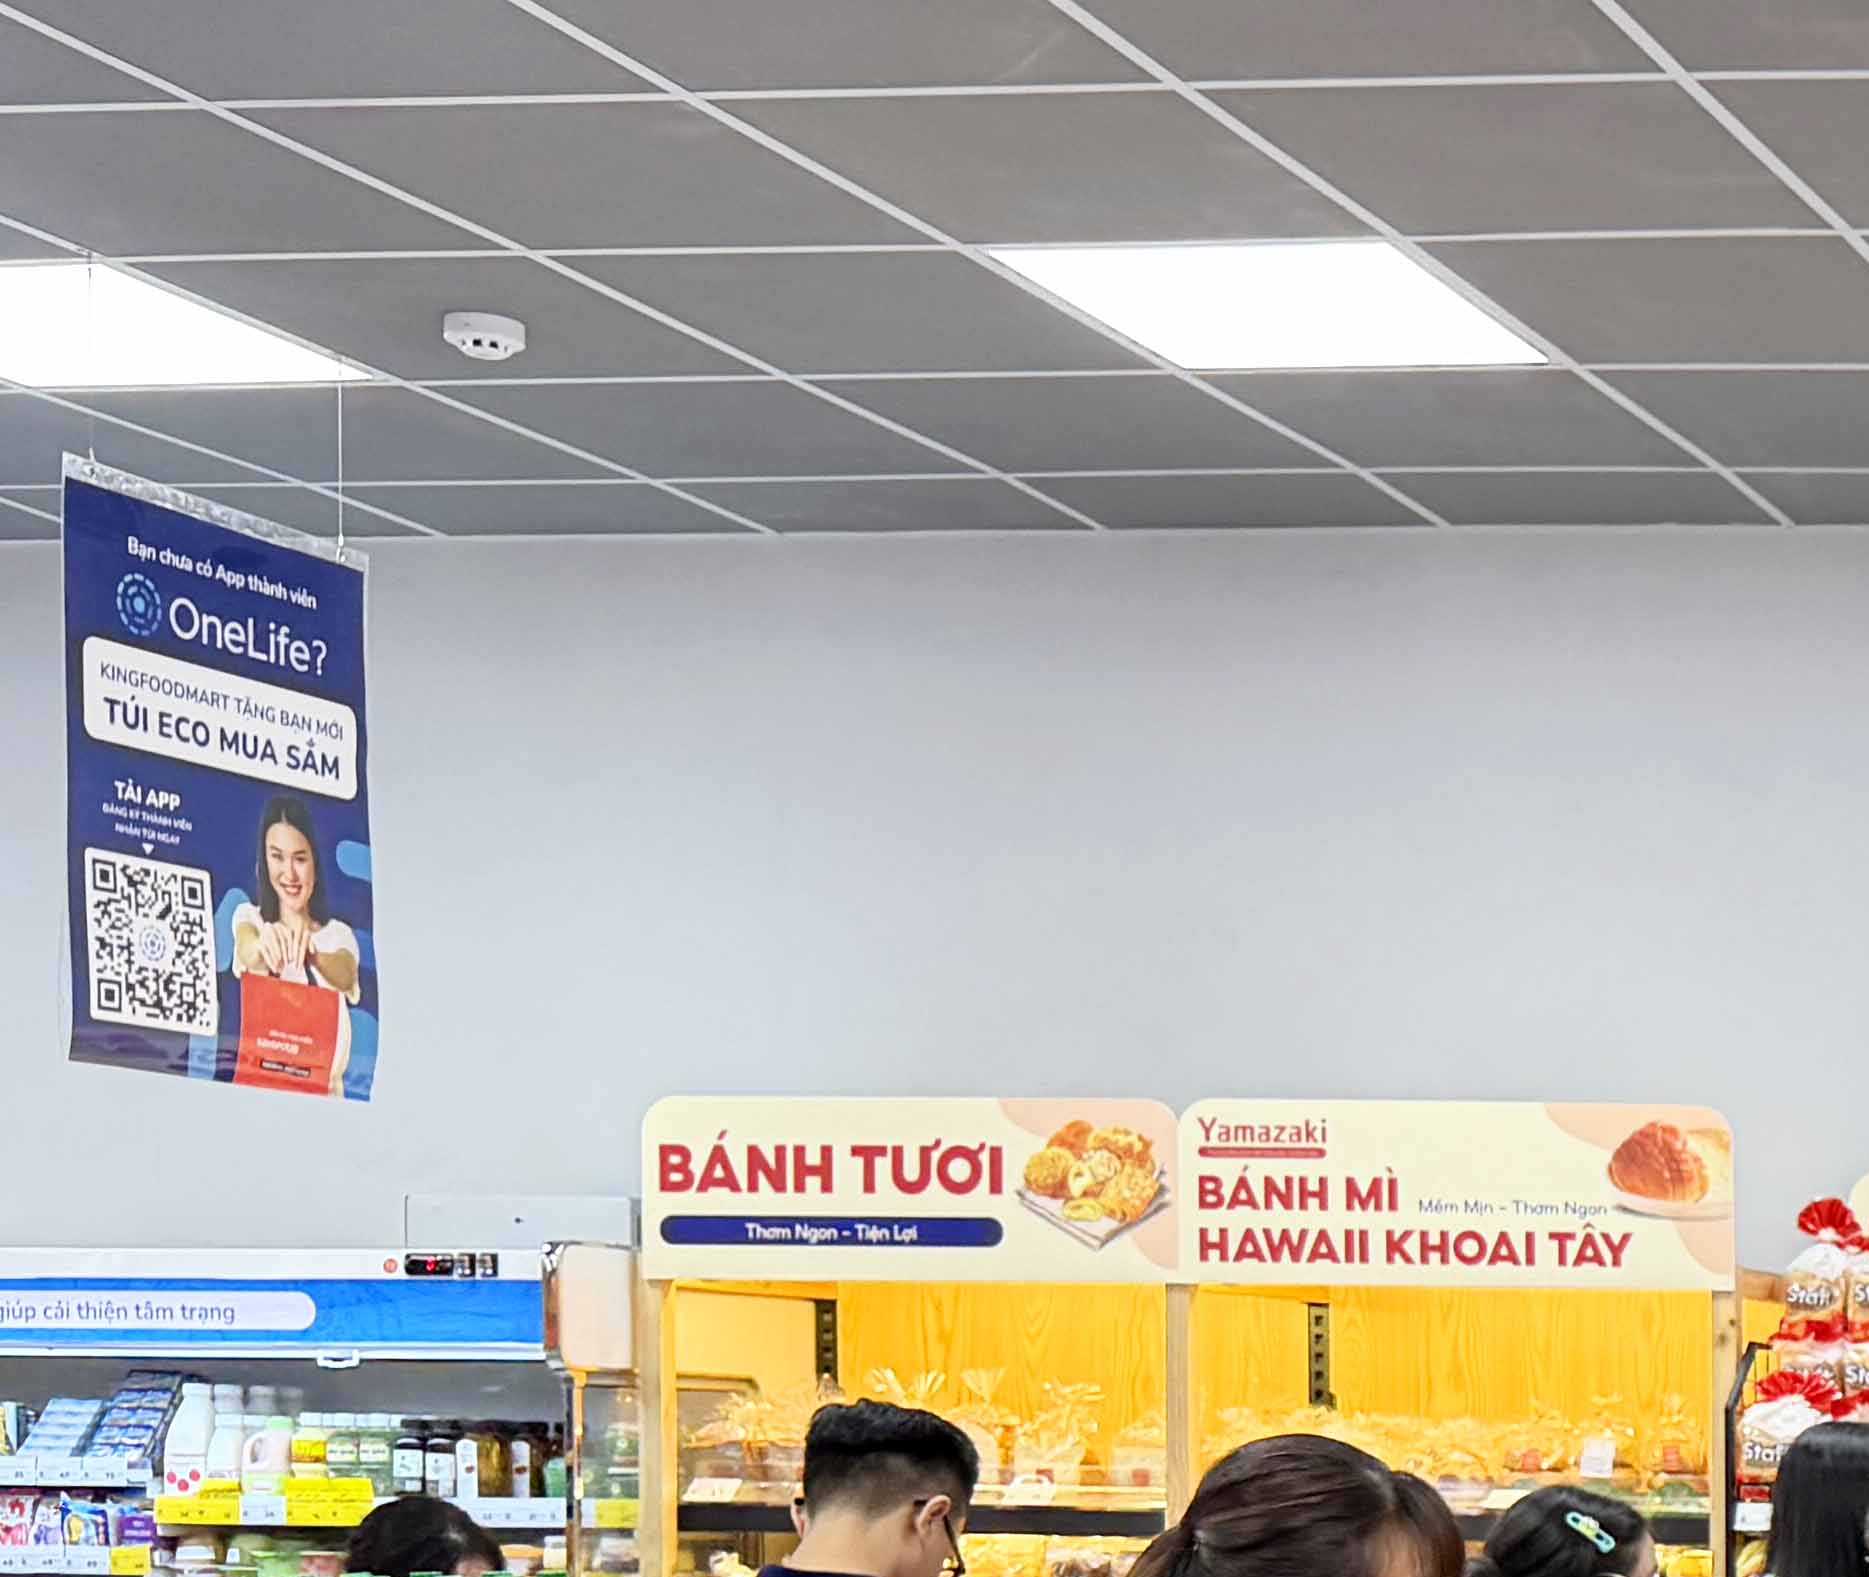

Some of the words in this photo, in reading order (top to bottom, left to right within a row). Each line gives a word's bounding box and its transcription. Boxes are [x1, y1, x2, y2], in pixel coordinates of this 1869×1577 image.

[127, 535, 156, 561] Bạn
[159, 547, 193, 573] chưa
[196, 558, 213, 577] có
[215, 565, 245, 590] App
[169, 597, 328, 676] OneLife?
[100, 660, 231, 710] KINGFOODMART
[280, 709, 313, 735] BẠN
[103, 695, 149, 732] TÚI
[158, 711, 210, 747] ECO
[220, 727, 278, 766] MUA
[286, 738, 341, 780] SẮM
[145, 787, 181, 811] APP
[1198, 1116, 1327, 1145] Yamazaki
[657, 1130, 834, 1194] BÁNH
[851, 1137, 1004, 1196] TƯƠI
[1198, 1165, 1329, 1212] BÁNH
[1345, 1166, 1399, 1213] MÌ
[1562, 1202, 1608, 1220] Ngon
[745, 1222, 793, 1242] Thơm
[795, 1223, 838, 1244] Ngon
[856, 1222, 890, 1245] Tiện
[893, 1223, 918, 1244] Lợi
[1199, 1227, 1370, 1265] HAWAII
[1385, 1229, 1537, 1268] KHOAI
[1549, 1222, 1633, 1269] TÂY
[44, 1298, 71, 1321] cải
[76, 1299, 130, 1324] thiện
[134, 1301, 174, 1321] tâm
[180, 1303, 236, 1327] trạng
